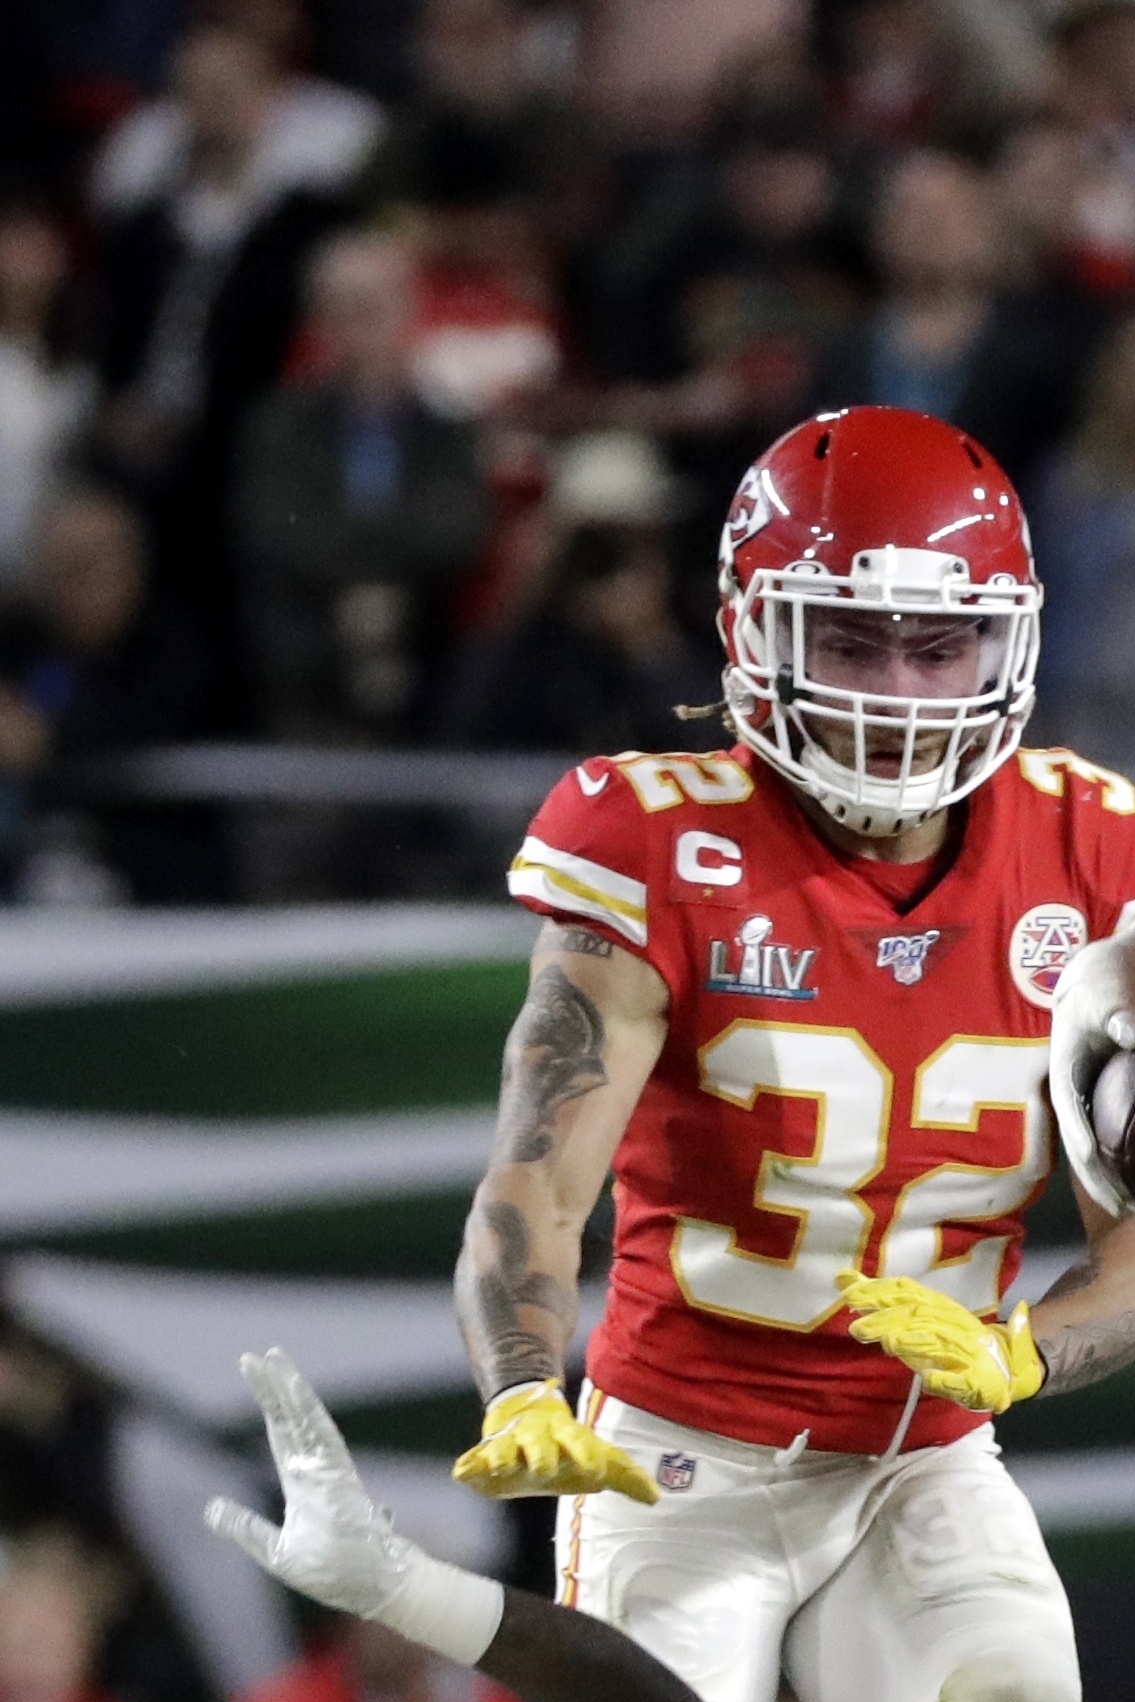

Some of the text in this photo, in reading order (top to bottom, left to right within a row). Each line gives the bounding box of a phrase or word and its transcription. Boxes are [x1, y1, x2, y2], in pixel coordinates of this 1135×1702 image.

[675, 830, 744, 887] C
[708, 939, 818, 991] LIV
[670, 1017, 1051, 1333] 32
